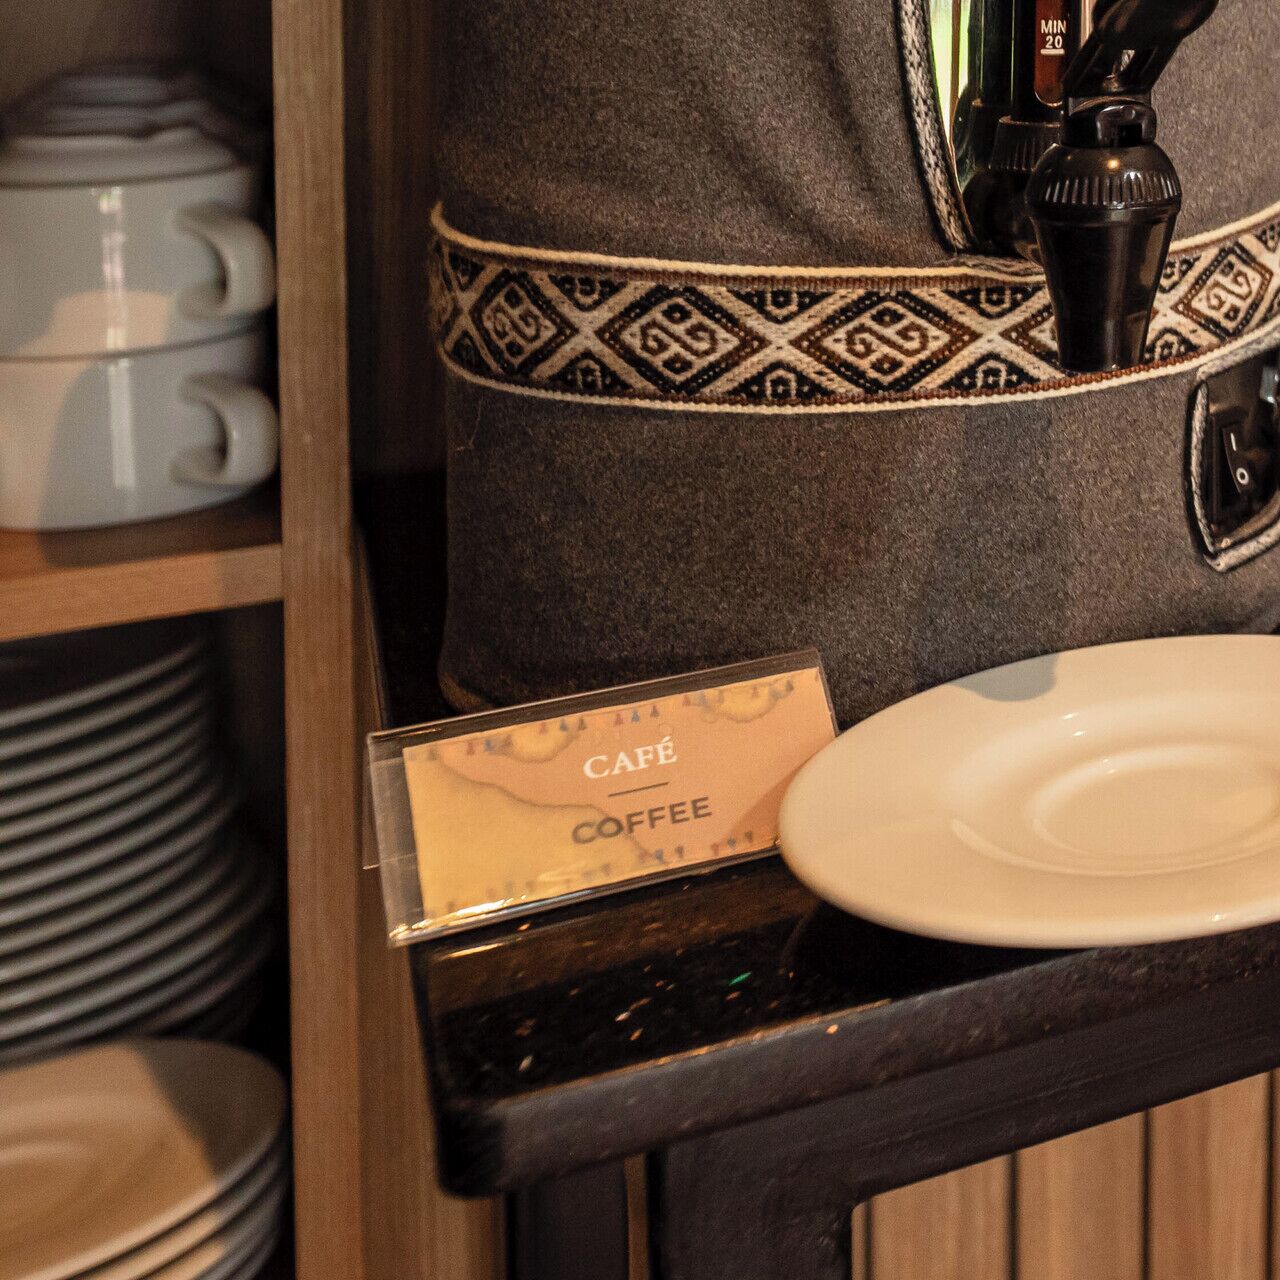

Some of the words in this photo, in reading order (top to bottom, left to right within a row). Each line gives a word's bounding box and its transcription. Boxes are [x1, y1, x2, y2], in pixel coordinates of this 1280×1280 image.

[1040, 19, 1067, 34] MIN
[1045, 35, 1063, 49] 20
[582, 735, 678, 780] CAFÉ
[571, 795, 713, 846] COFFEE
